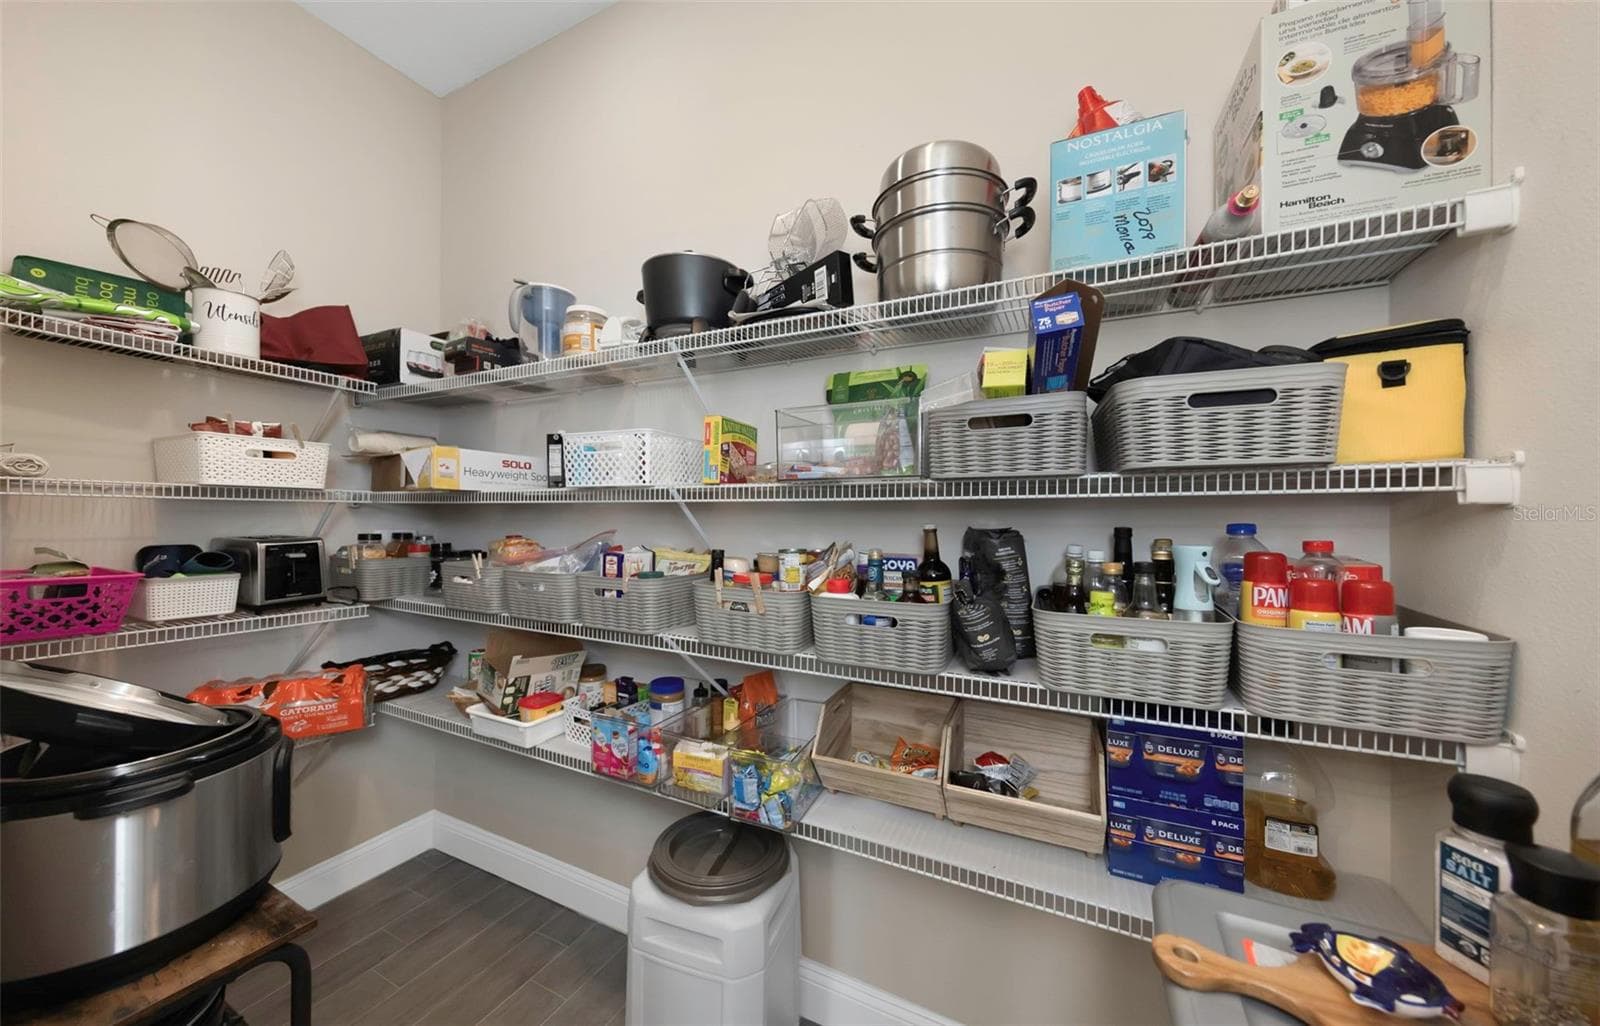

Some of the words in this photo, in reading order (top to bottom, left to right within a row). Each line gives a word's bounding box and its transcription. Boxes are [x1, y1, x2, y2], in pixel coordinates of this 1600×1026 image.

[1067, 119, 1163, 153] NOSTALGIA
[1279, 194, 1331, 209] Hamilton
[1308, 197, 1345, 210] Beach
[1037, 316, 1052, 326] 75
[501, 459, 532, 471] SOLO
[463, 466, 529, 482] Heavyweight
[530, 472, 548, 482] Spo
[1253, 586, 1288, 608] PAM
[1342, 616, 1375, 635] AM
[280, 702, 338, 717] GATORADE
[1108, 738, 1129, 748] LUXE
[1157, 744, 1200, 758] DELUXE
[1110, 821, 1132, 832] LUXE
[1218, 821, 1240, 831] PACK
[1158, 829, 1201, 845] DELUXE
[1445, 857, 1493, 889] SALT
